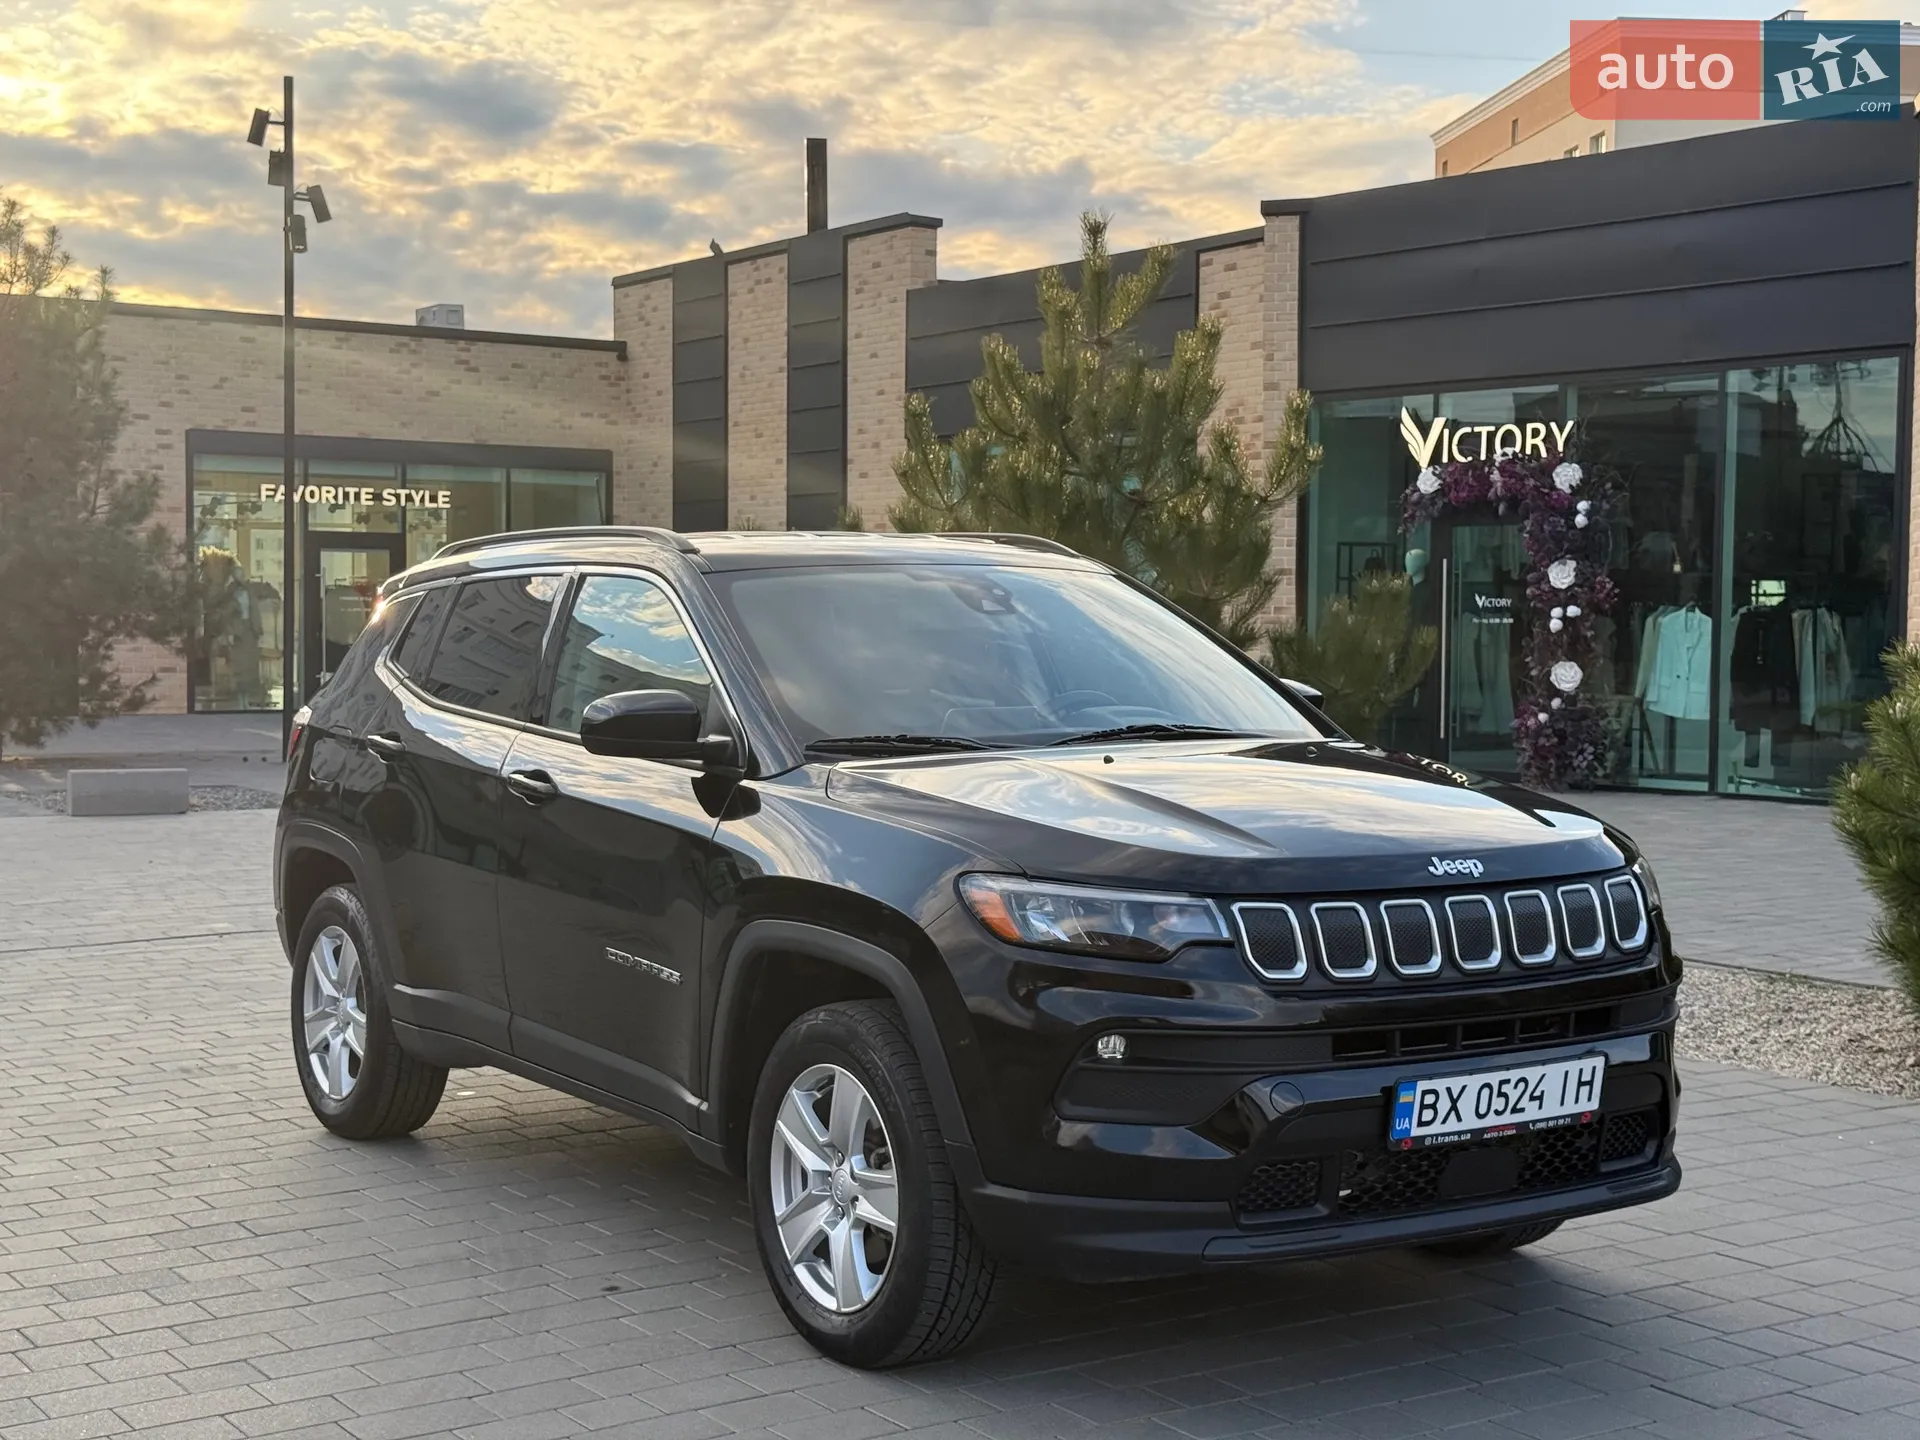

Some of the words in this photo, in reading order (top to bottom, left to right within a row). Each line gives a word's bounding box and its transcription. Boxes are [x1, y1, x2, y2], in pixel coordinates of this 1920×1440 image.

[1400, 406, 1575, 472] VICTORY
[381, 487, 451, 508] STYLE
[1474, 592, 1512, 609] VICTORY
[1427, 856, 1484, 878] Jeep
[605, 946, 682, 985] COMPASS
[1416, 1084, 1468, 1128] BX
[1474, 1073, 1547, 1120] 0524
[1559, 1065, 1597, 1107] IH
[1395, 1118, 1410, 1131] UA
